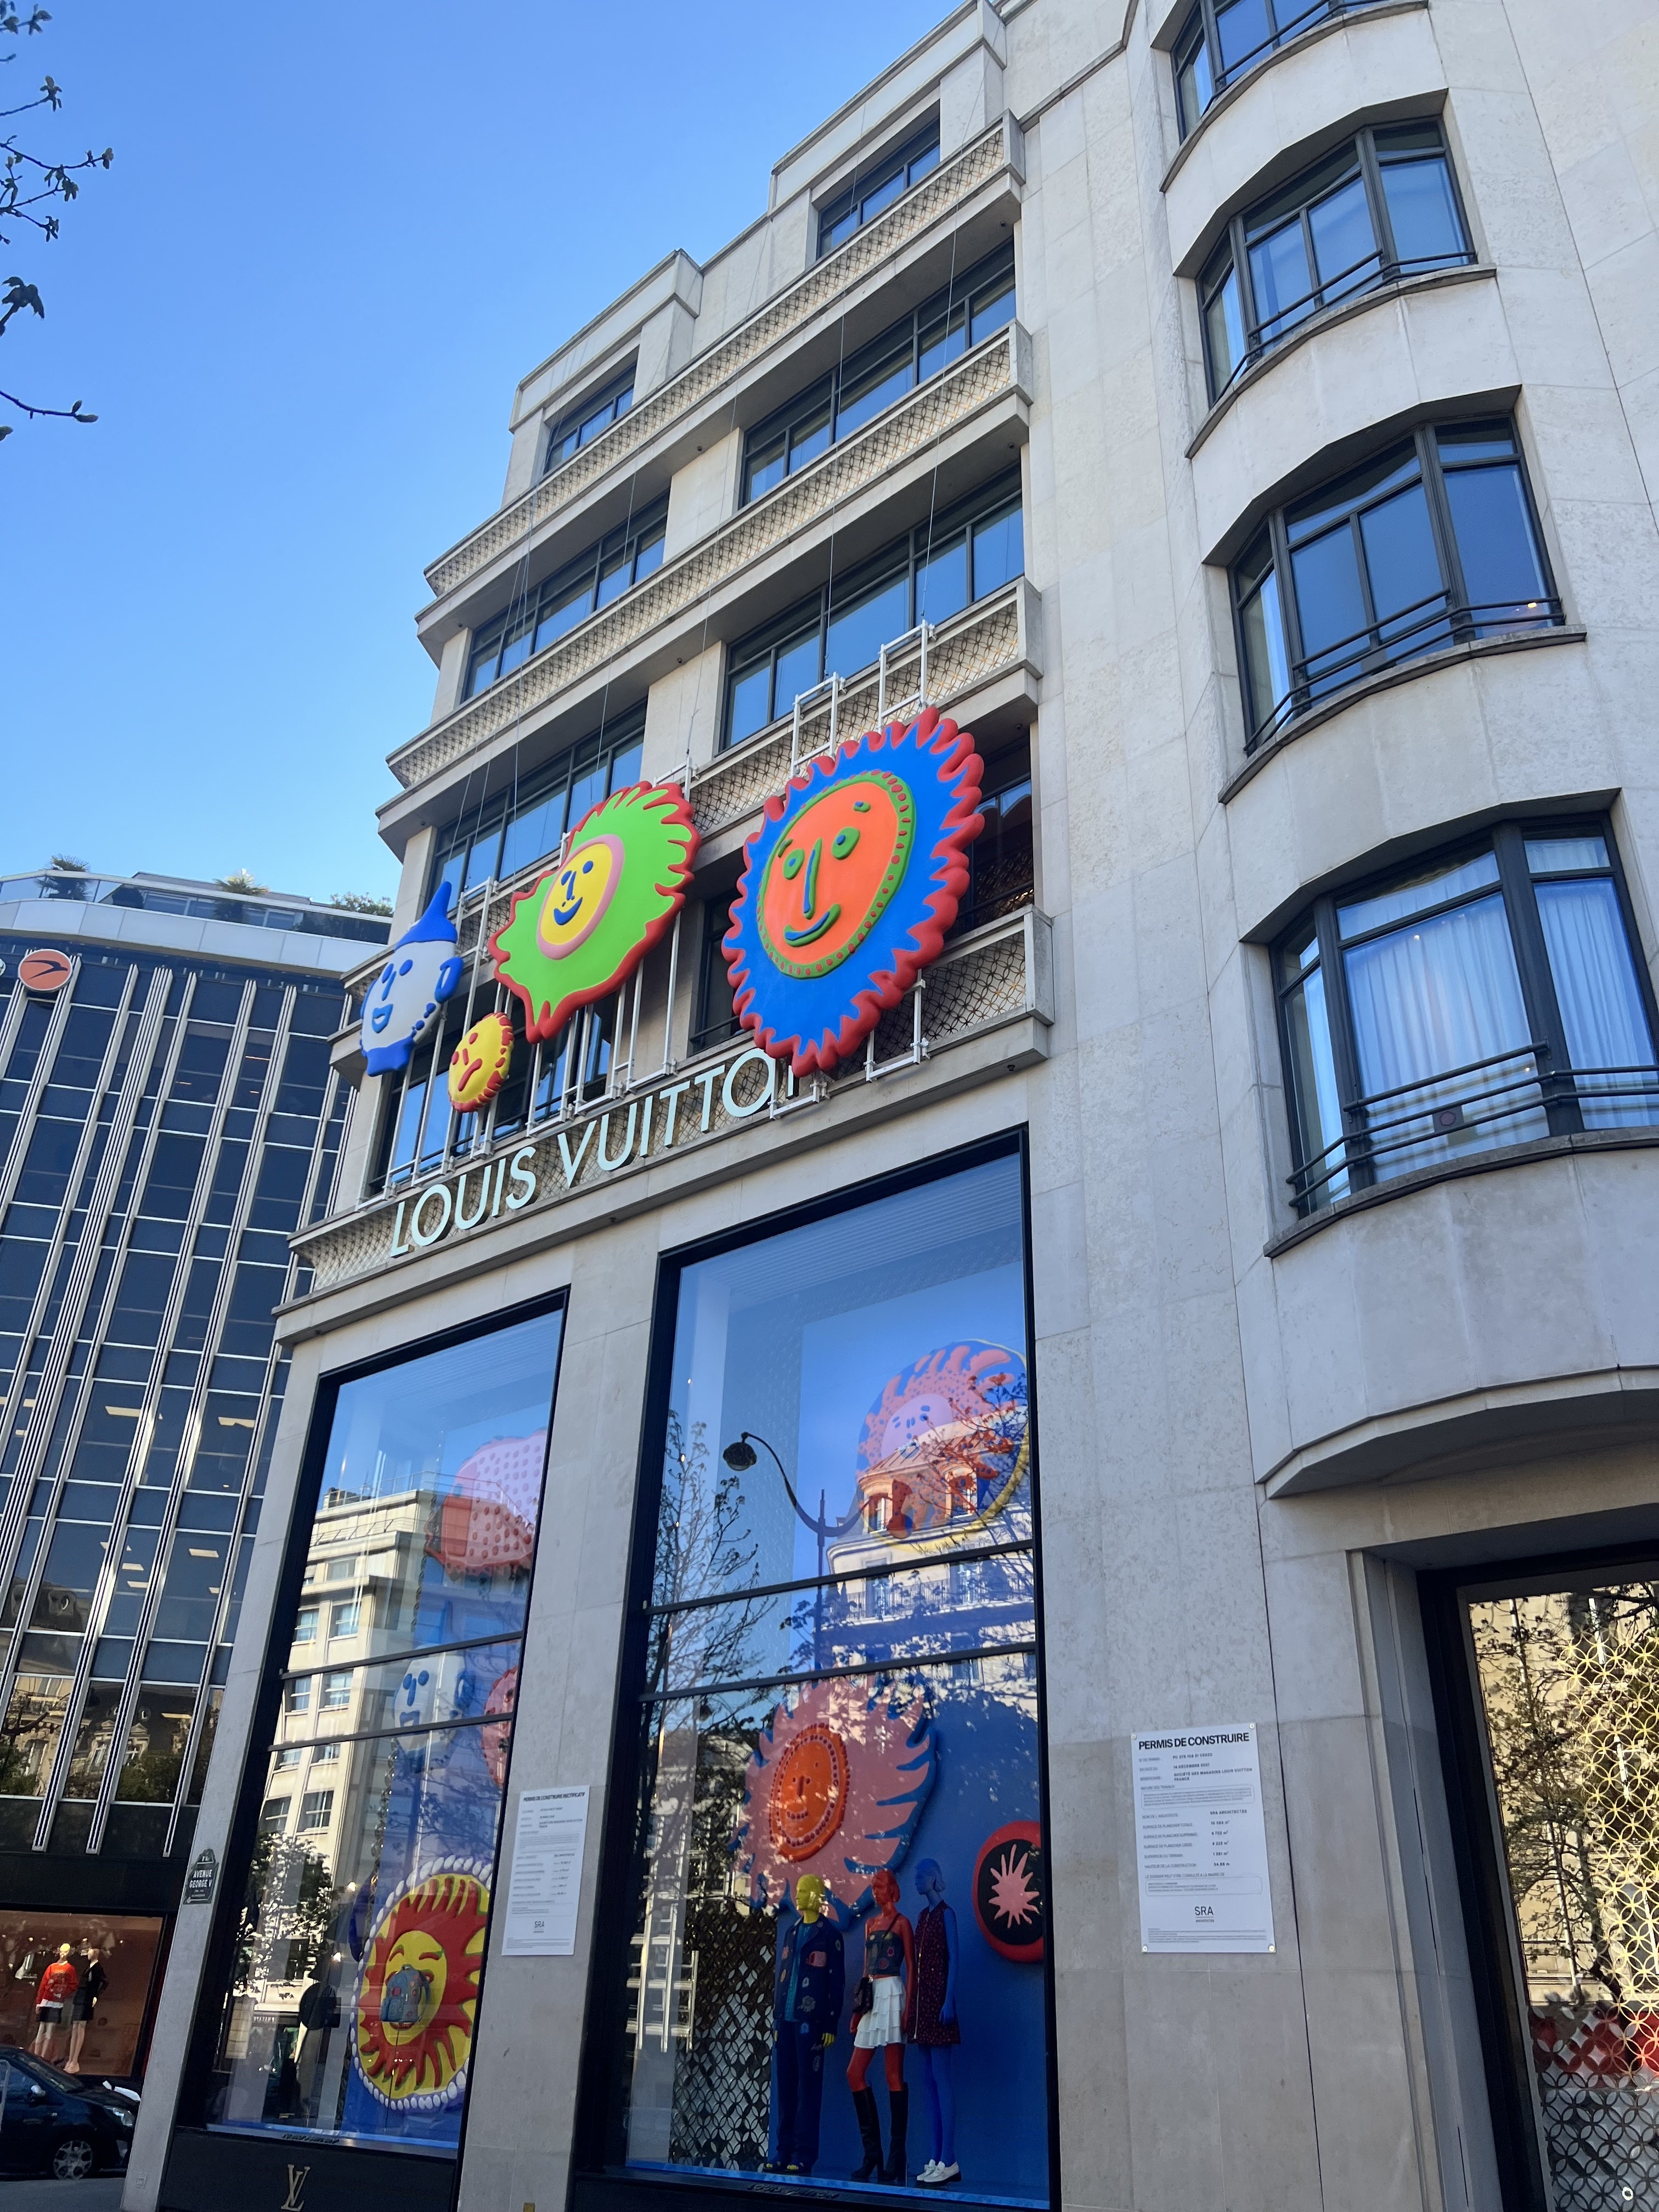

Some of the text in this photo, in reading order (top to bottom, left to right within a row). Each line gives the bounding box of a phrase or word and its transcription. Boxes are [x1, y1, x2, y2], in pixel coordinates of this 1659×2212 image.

[391, 1146, 536, 1257] LOUIS
[1139, 1733, 1250, 1750] PERMIS DE CONSTRUIRE
[193, 1869, 212, 1878] AVENUE
[189, 1880, 208, 1888] GEORGE
[1194, 1906, 1214, 1916] SRA
